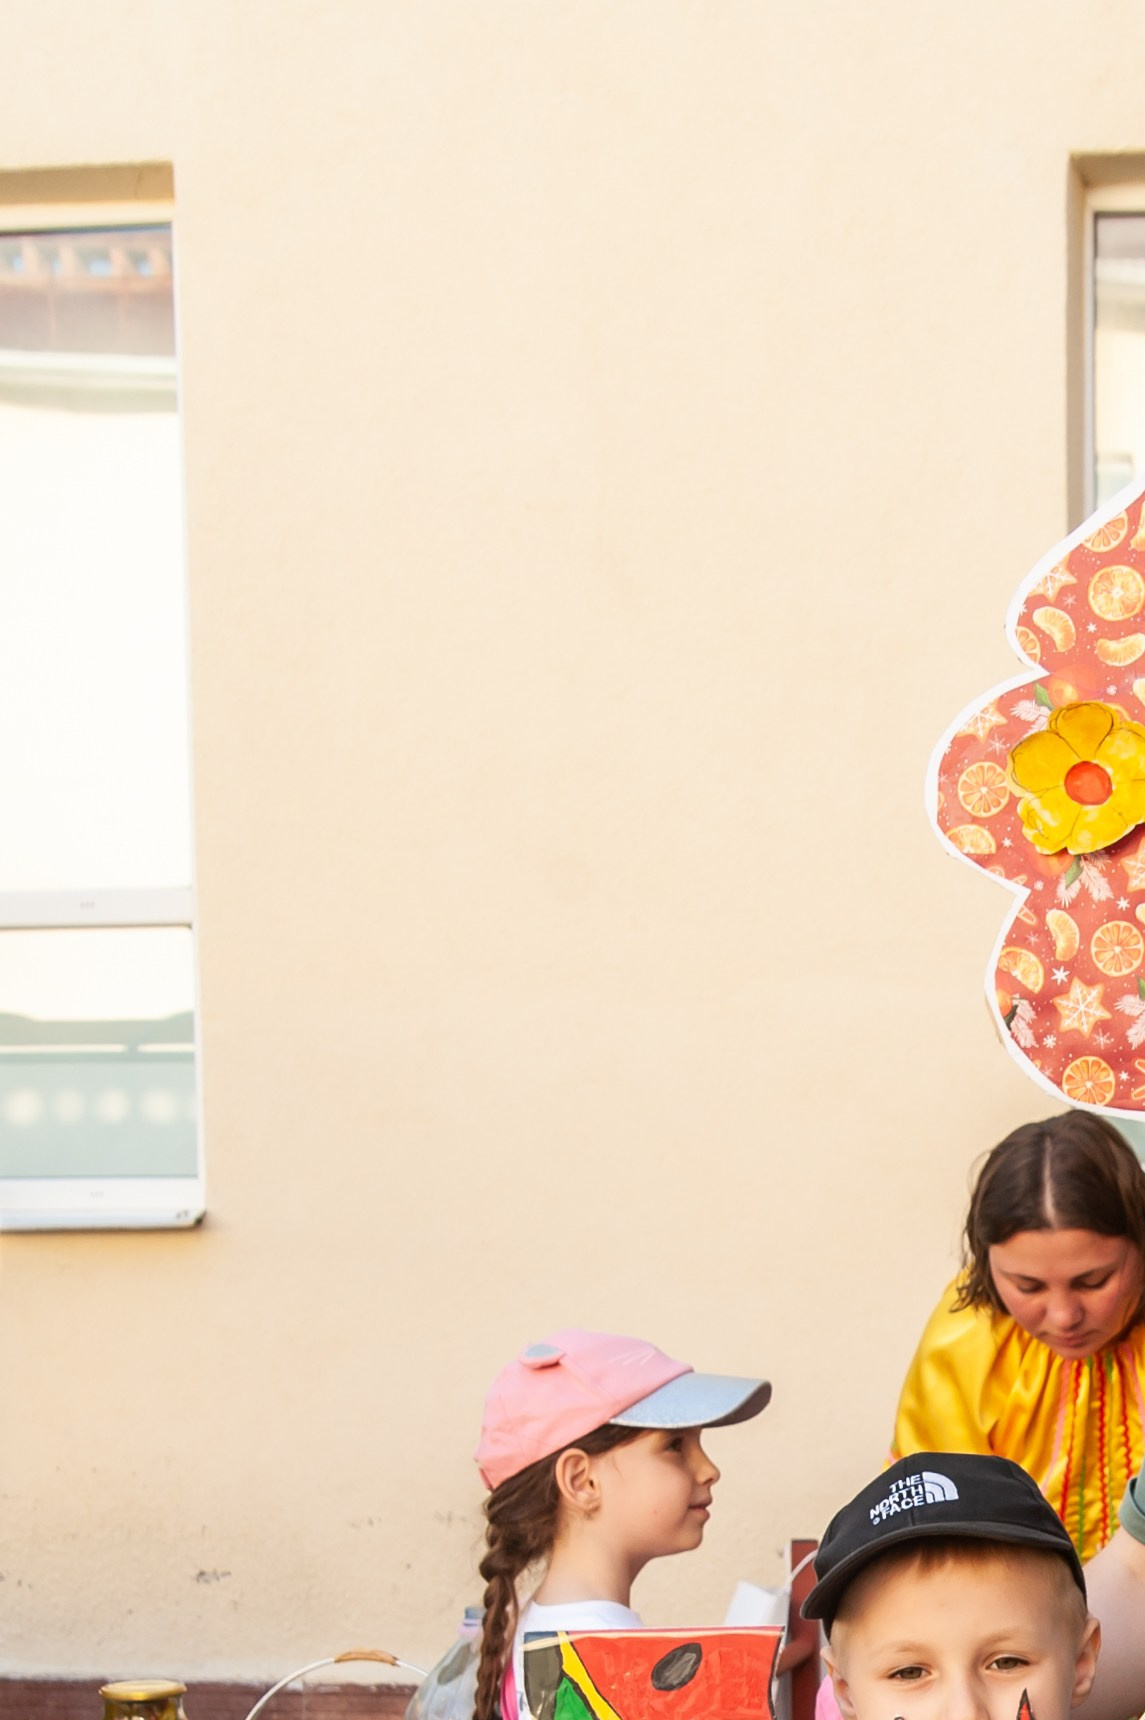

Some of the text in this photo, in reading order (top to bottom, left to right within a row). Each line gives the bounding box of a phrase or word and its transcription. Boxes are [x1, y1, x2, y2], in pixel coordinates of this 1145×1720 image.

[889, 1474, 921, 1493] THE
[870, 1484, 924, 1520] NORTH
[880, 1494, 925, 1520] FACE
